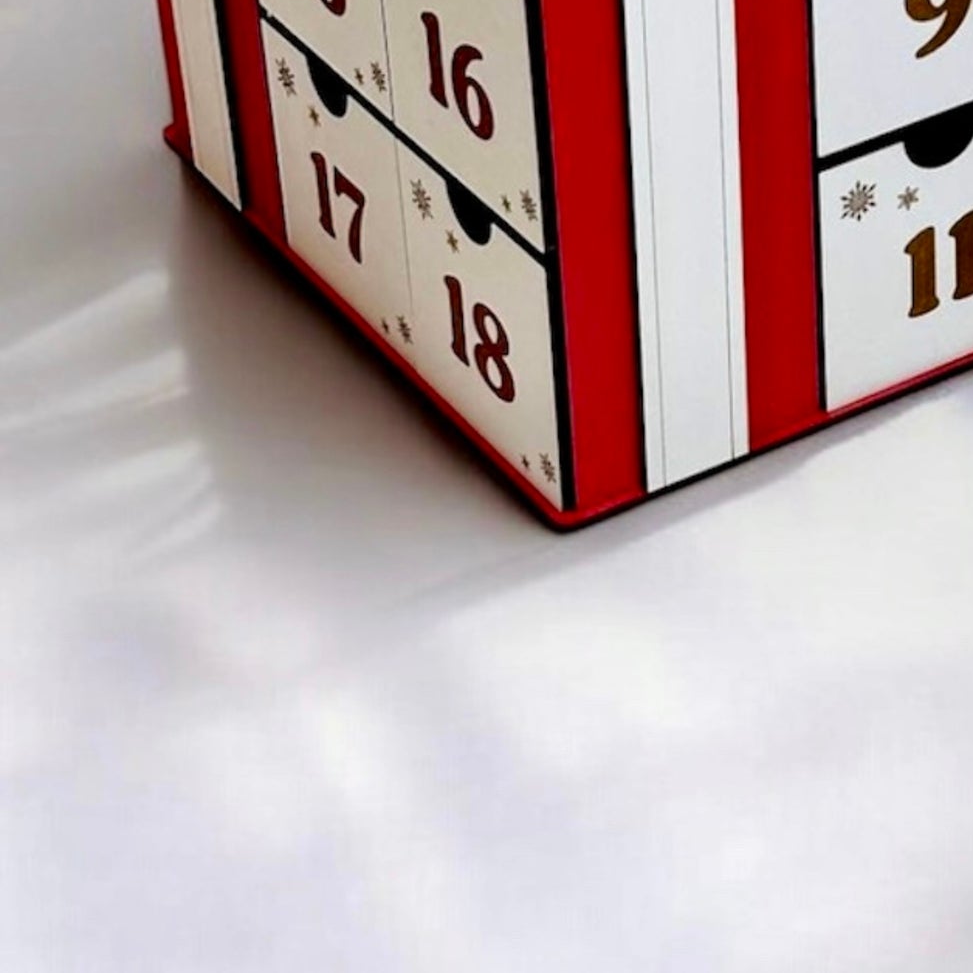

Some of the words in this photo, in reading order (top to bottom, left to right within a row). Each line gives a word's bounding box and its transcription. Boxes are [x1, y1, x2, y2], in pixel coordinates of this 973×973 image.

[421, 12, 494, 140] 16
[311, 152, 365, 263] 17
[444, 275, 515, 403] 18
